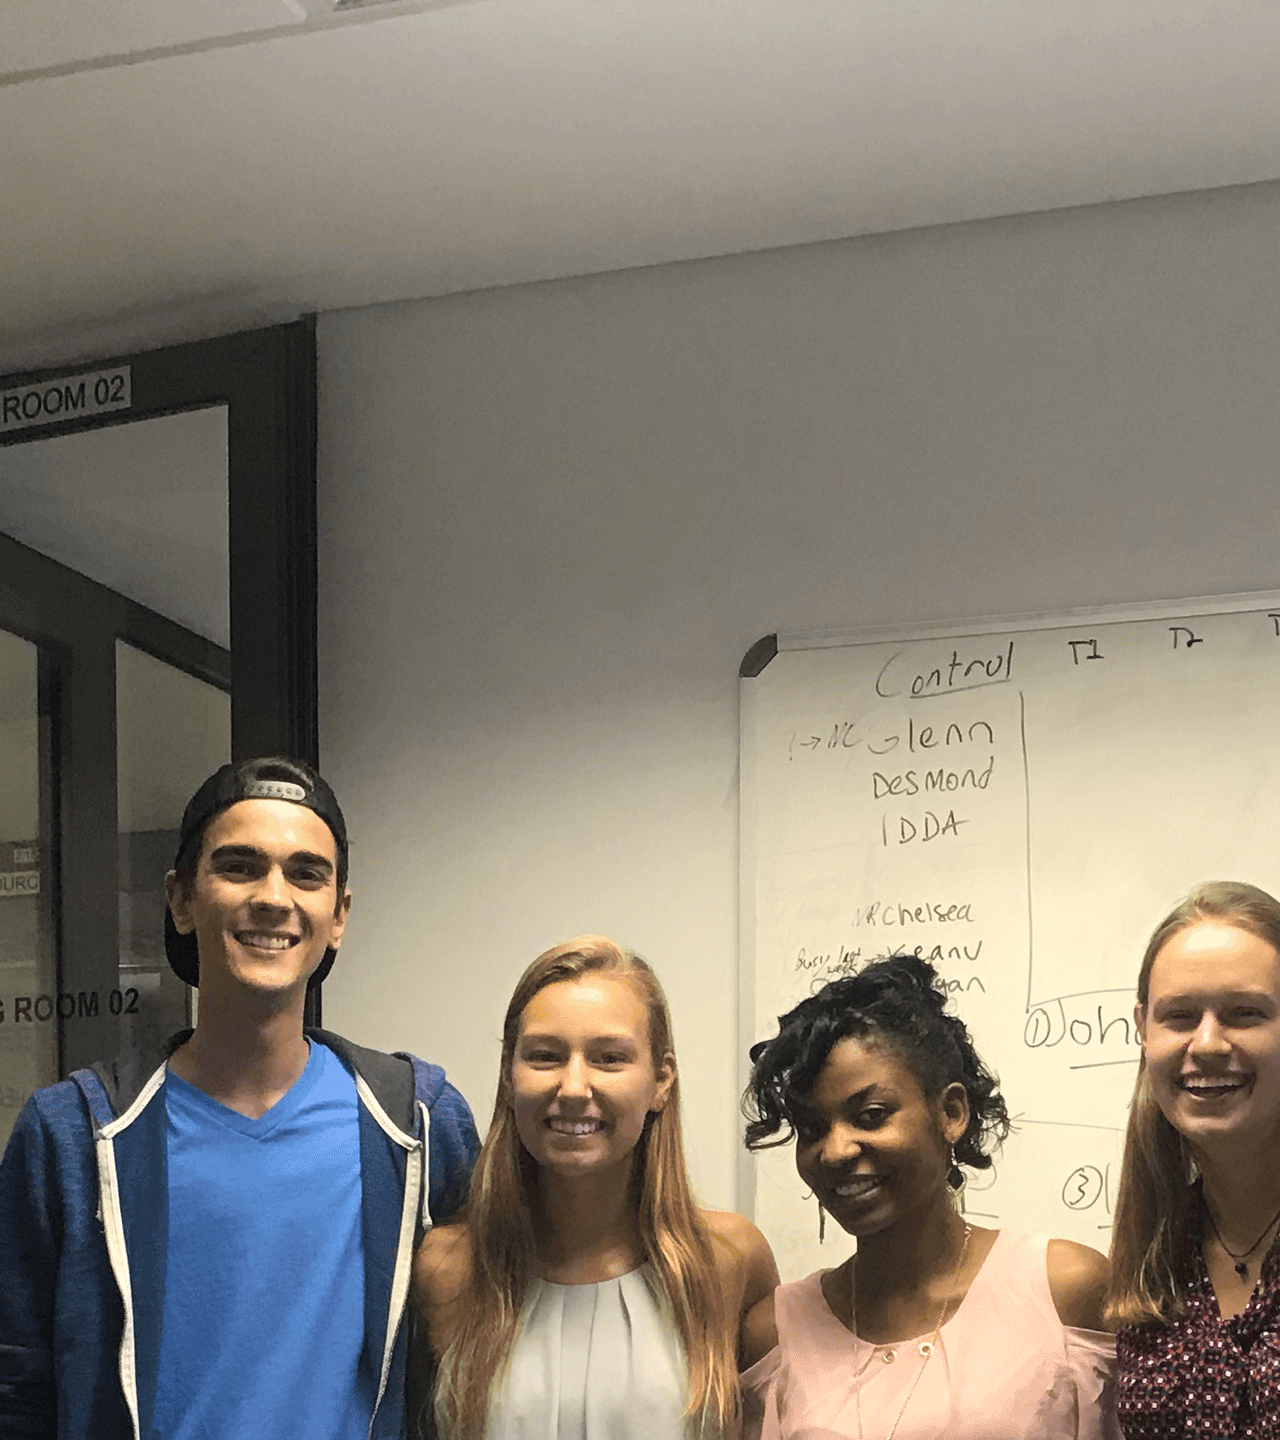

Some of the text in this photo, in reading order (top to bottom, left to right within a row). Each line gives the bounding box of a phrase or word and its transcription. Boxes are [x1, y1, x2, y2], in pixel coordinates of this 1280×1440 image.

[2, 382, 86, 424] ROOM
[94, 374, 125, 406] 02
[875, 640, 1014, 698] Control
[1068, 638, 1104, 665] T1
[881, 901, 976, 927] Chelsea
[14, 991, 100, 1024] ROOM
[108, 987, 141, 1017] 02
